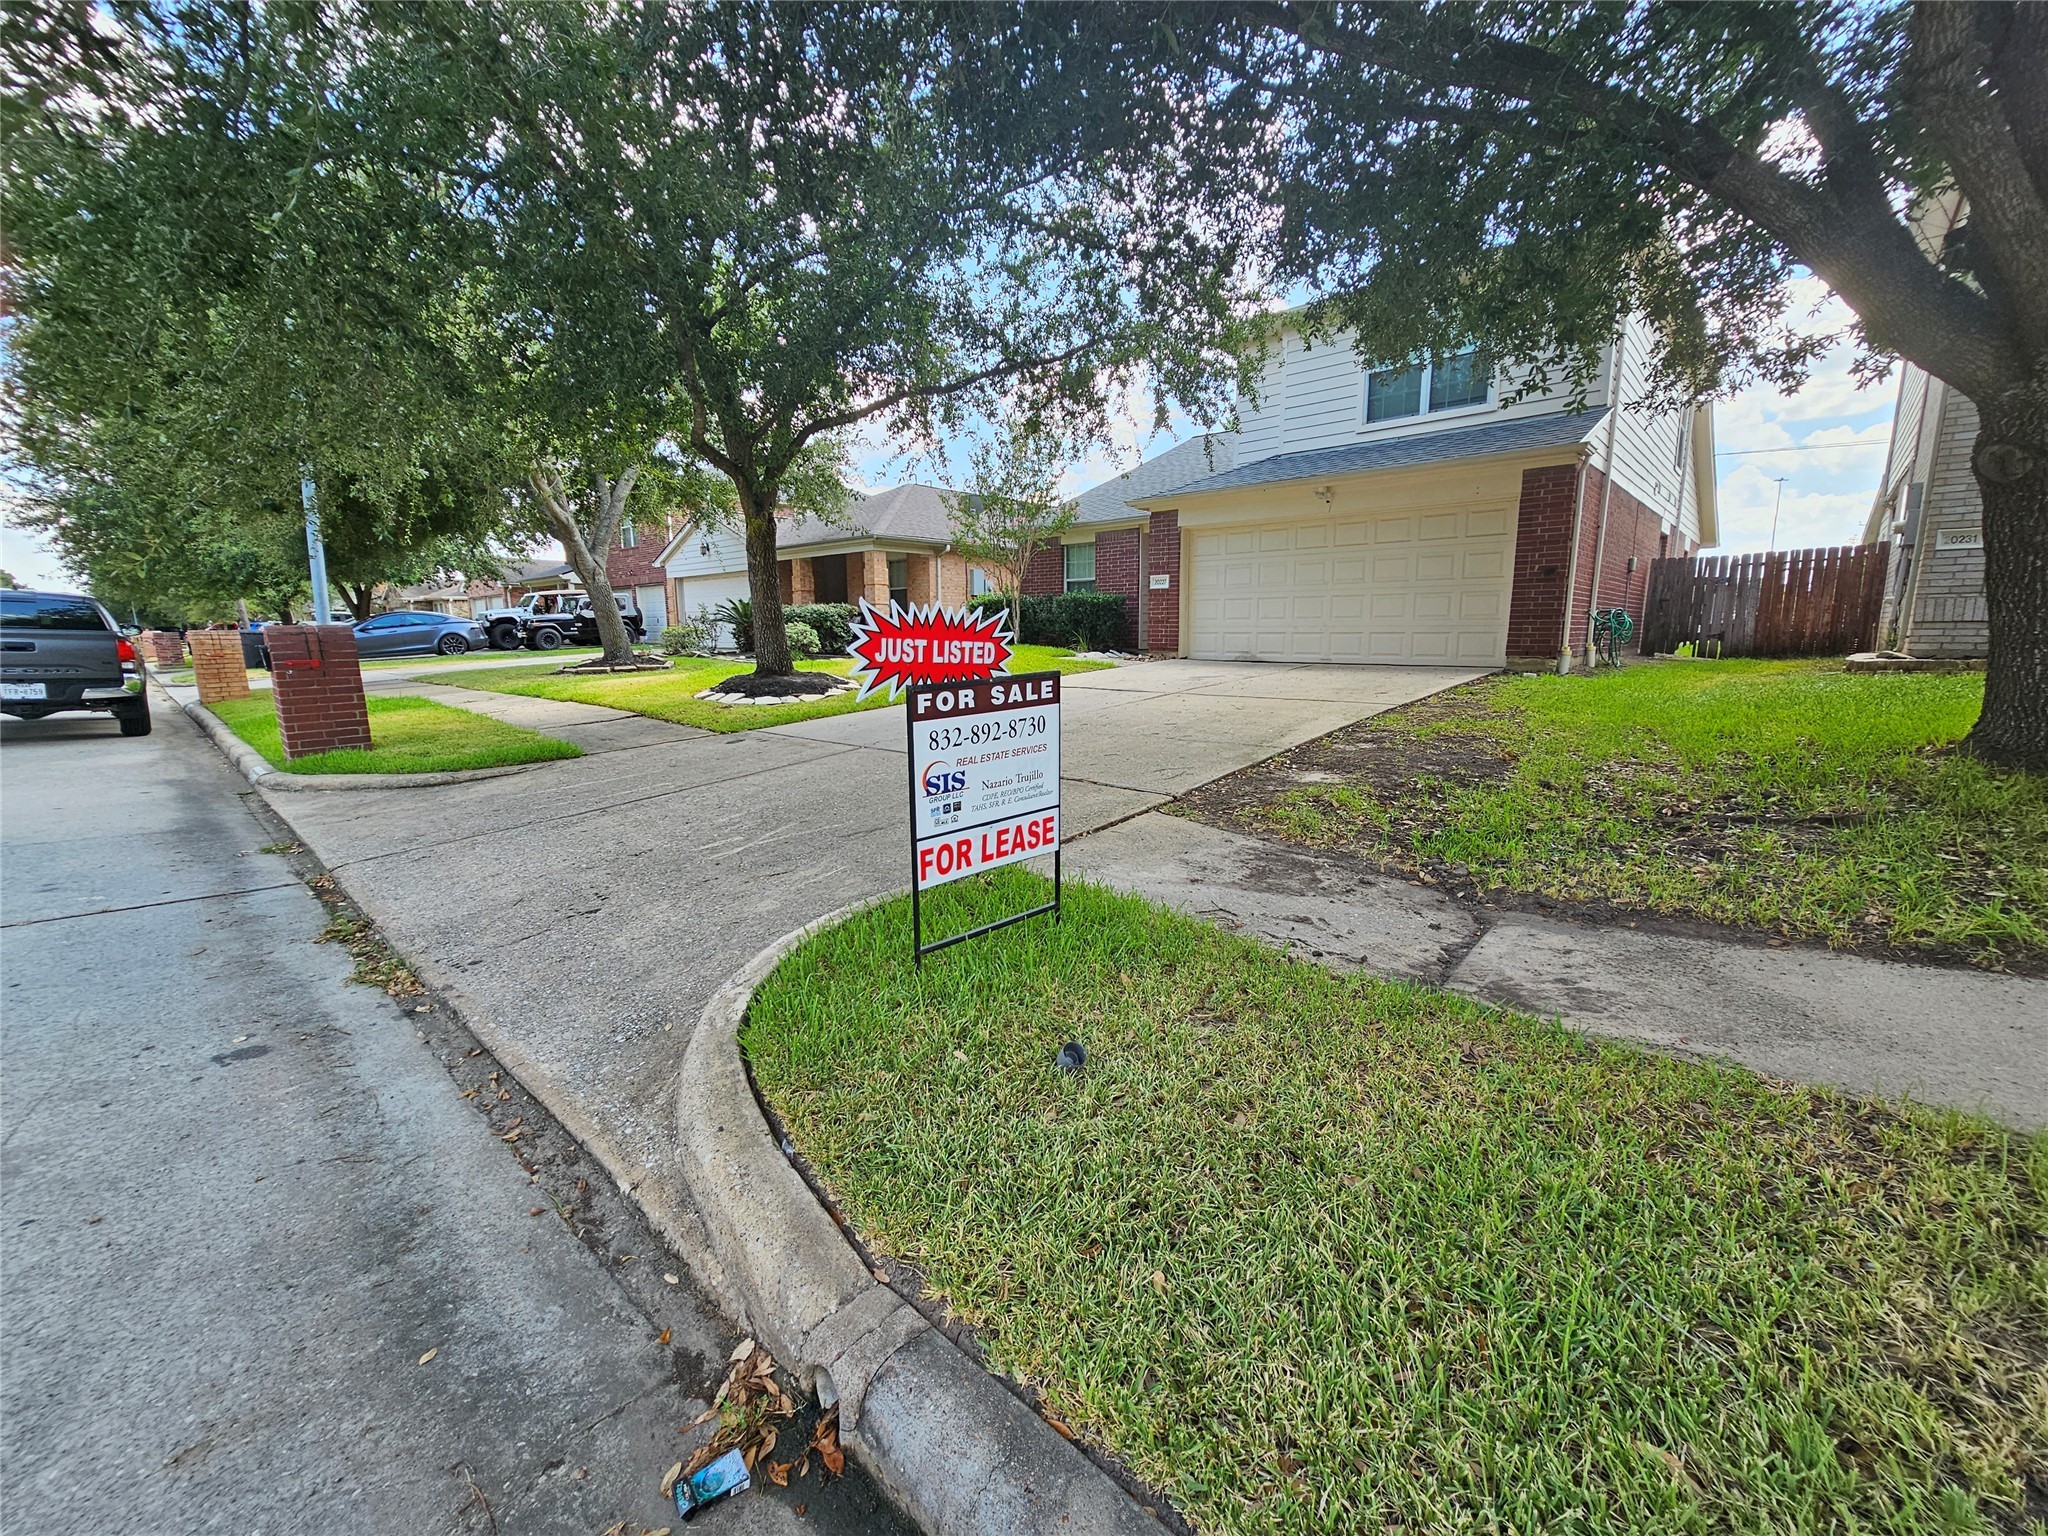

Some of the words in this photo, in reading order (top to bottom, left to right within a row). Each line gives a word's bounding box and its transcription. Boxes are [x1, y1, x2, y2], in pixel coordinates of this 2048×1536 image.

[1944, 534, 1977, 545] 20231
[874, 637, 928, 663] JUST
[932, 639, 996, 665] LISTED
[917, 689, 975, 714] FOR
[990, 680, 1054, 705] SALE
[928, 714, 1047, 751] 832-892-8730
[956, 755, 979, 767] REAL
[980, 750, 1010, 764] ESTATE
[1011, 743, 1048, 758] SERVICES
[925, 770, 966, 797] SIS
[981, 776, 1013, 791] Nazario
[1015, 769, 1044, 784] Trujillo
[929, 793, 951, 804] GROUP
[952, 791, 964, 799] LLC
[919, 838, 973, 882] FOR
[980, 815, 1055, 864] LEASE
